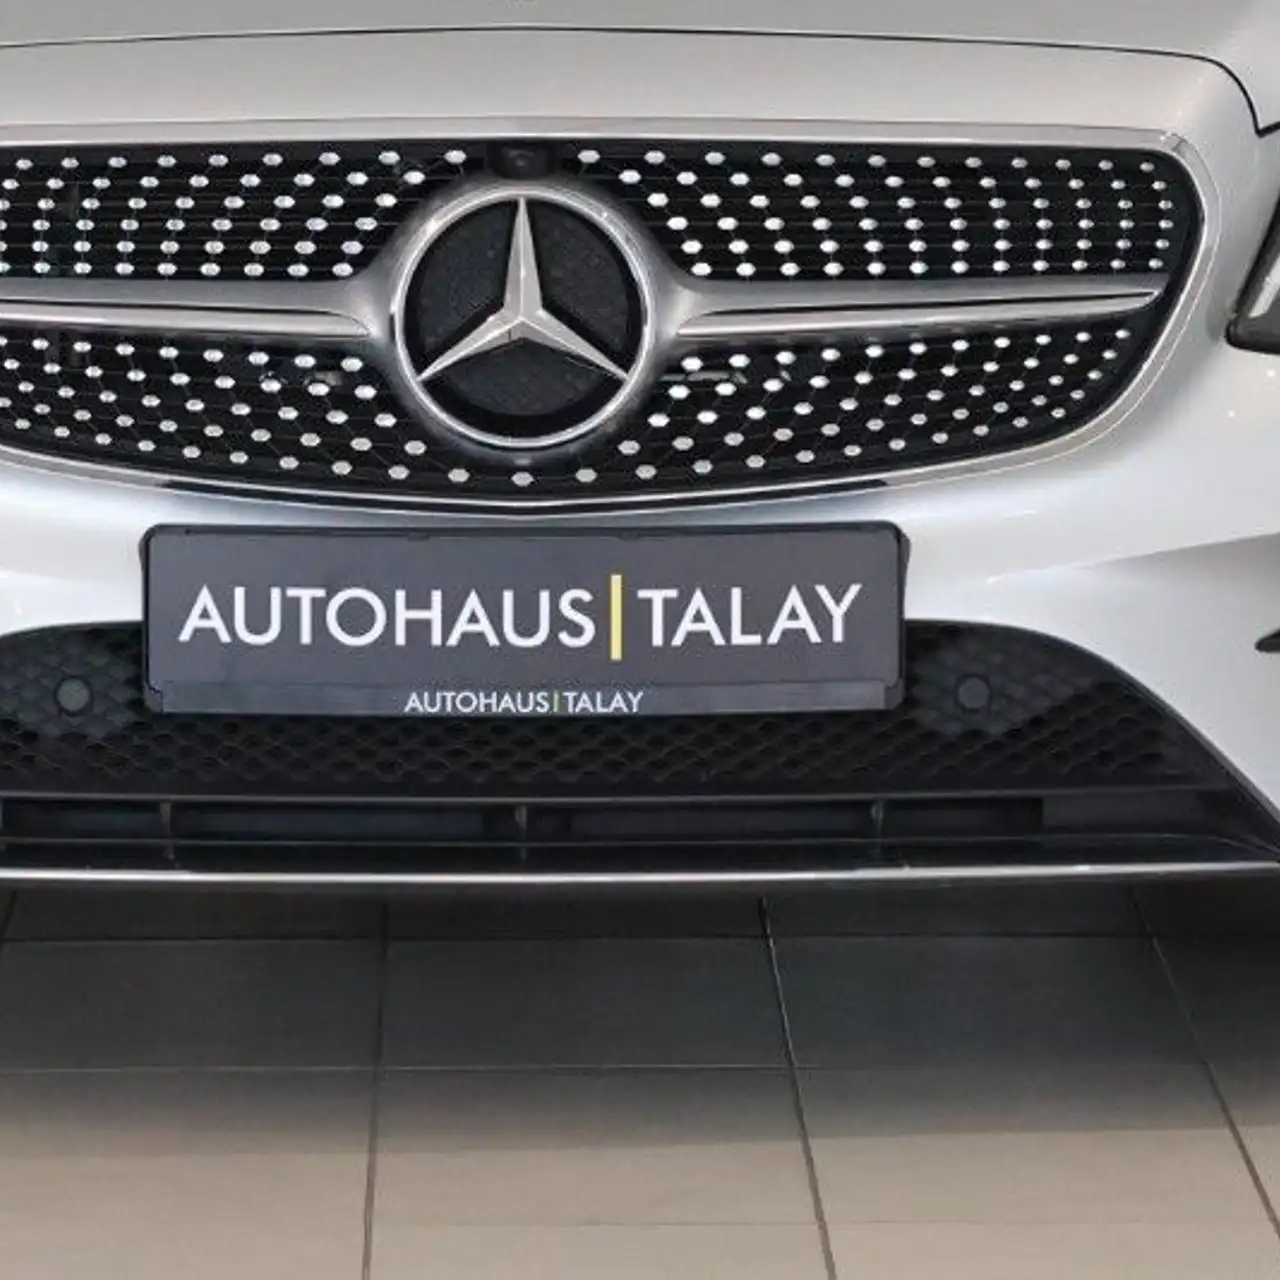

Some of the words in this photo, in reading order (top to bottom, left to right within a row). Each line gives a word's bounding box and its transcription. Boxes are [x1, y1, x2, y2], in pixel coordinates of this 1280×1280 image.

[177, 584, 596, 648] AUTOHAUS
[636, 583, 863, 647] TALAY
[404, 691, 550, 713] AUTOHAUS
[563, 691, 644, 713] TALAY
